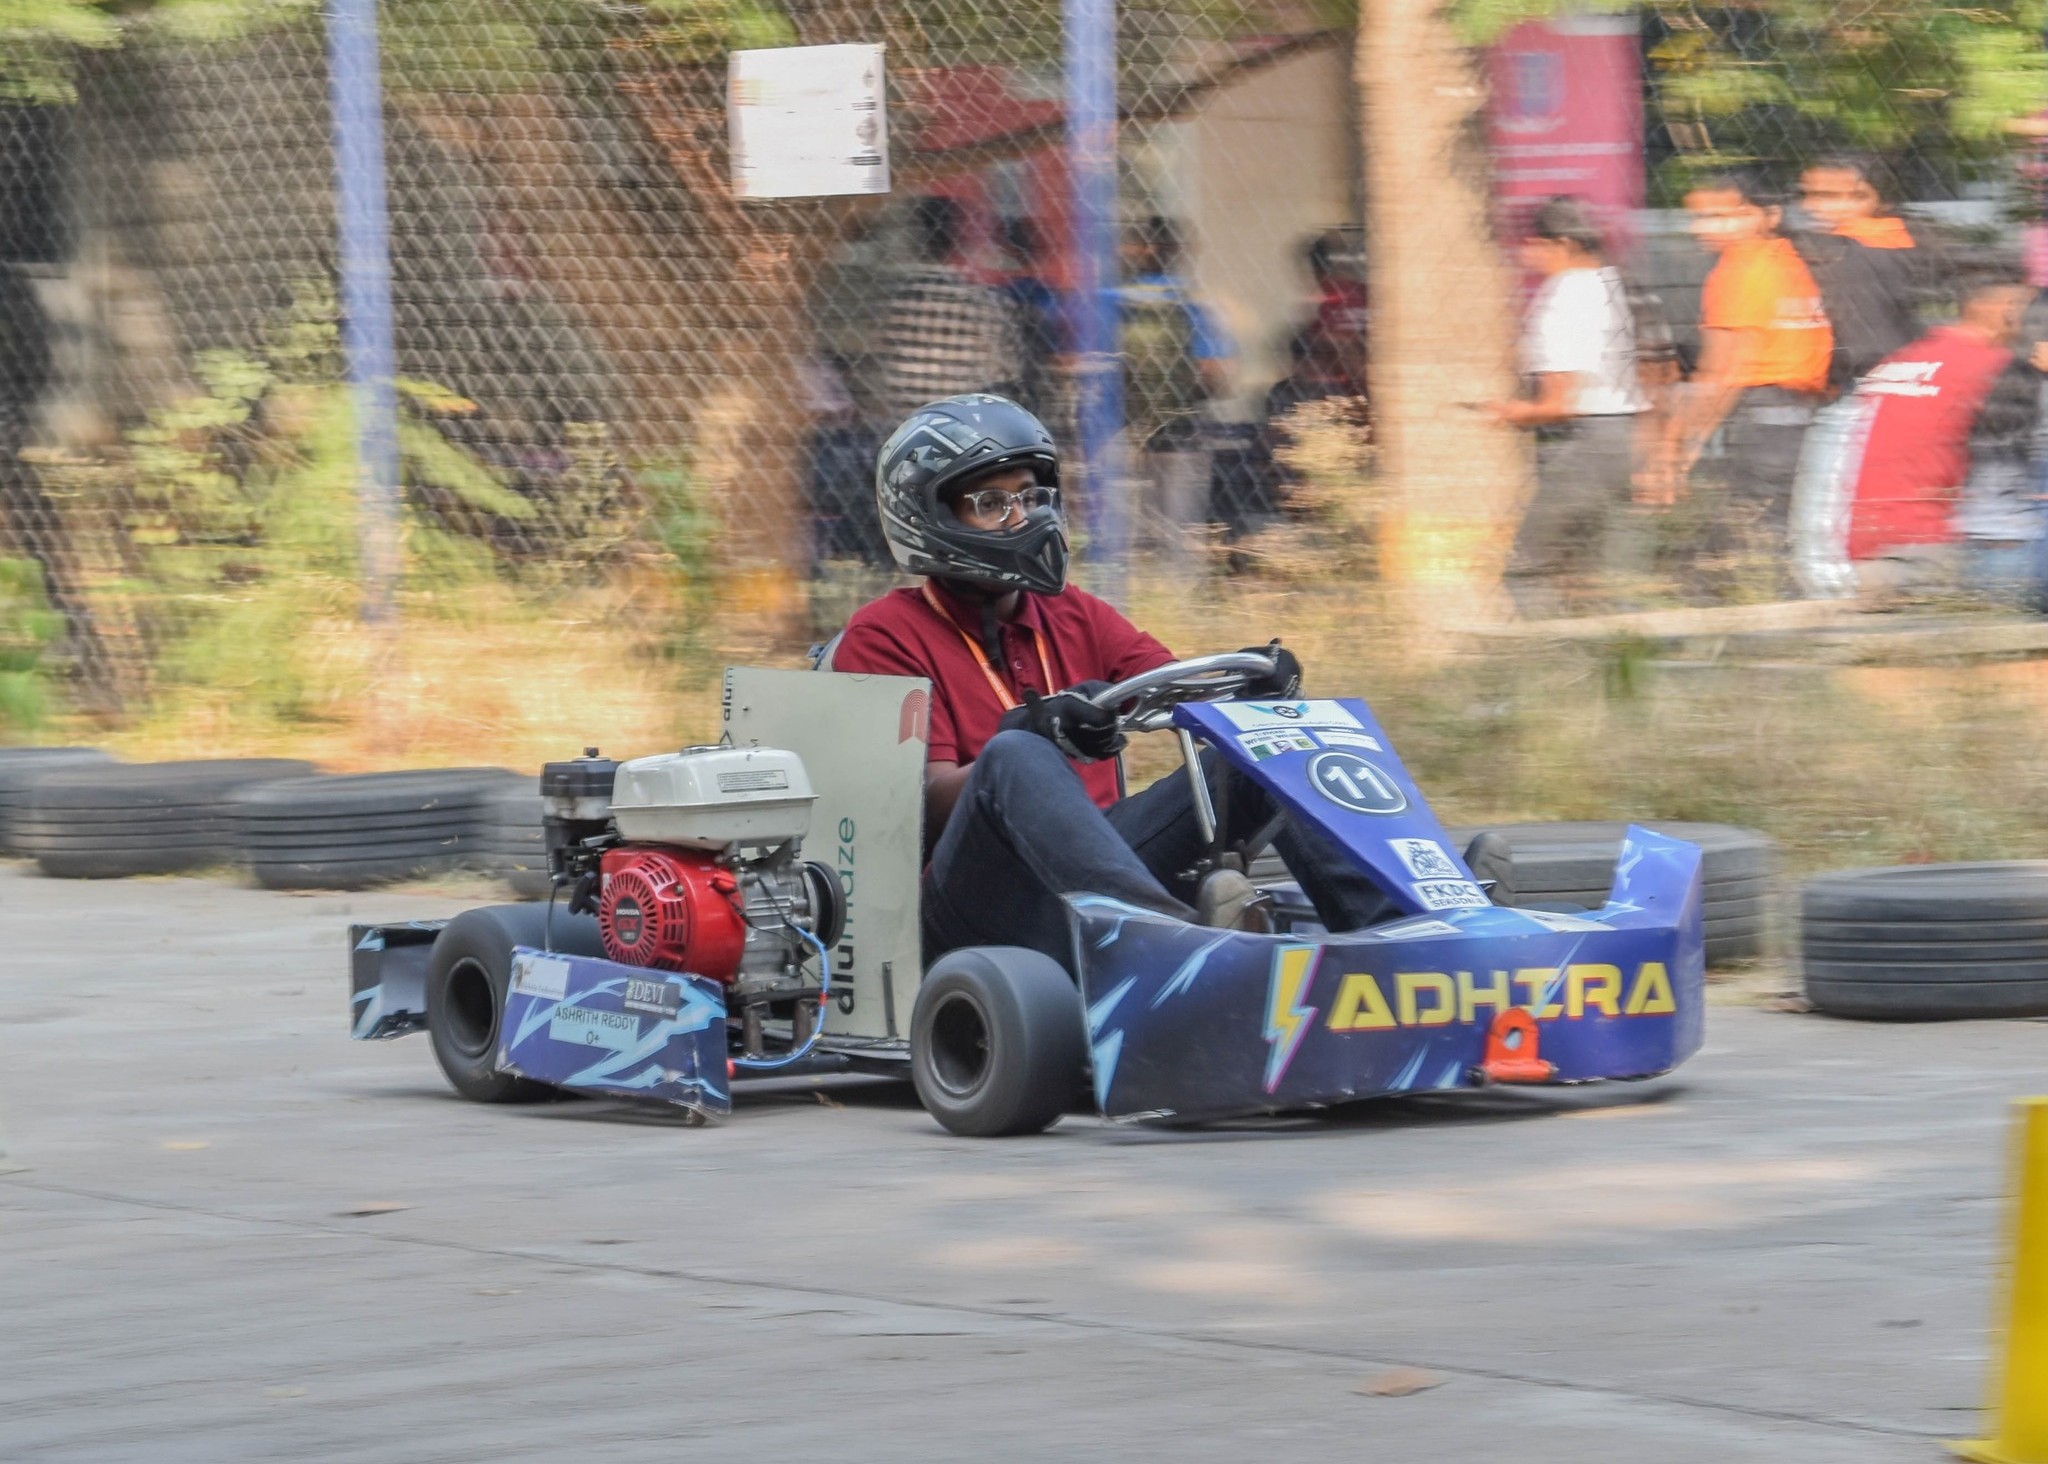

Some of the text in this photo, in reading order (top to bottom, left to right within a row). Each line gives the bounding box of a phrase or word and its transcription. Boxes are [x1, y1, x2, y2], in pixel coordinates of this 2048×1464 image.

[1324, 765, 1394, 799] 11
[1421, 883, 1479, 900] FKDC
[615, 908, 640, 916] HONDA
[634, 980, 666, 1004] DEVI
[1326, 962, 1677, 1032] ADHIRA
[554, 1007, 635, 1031] ASHRITH REDDY
